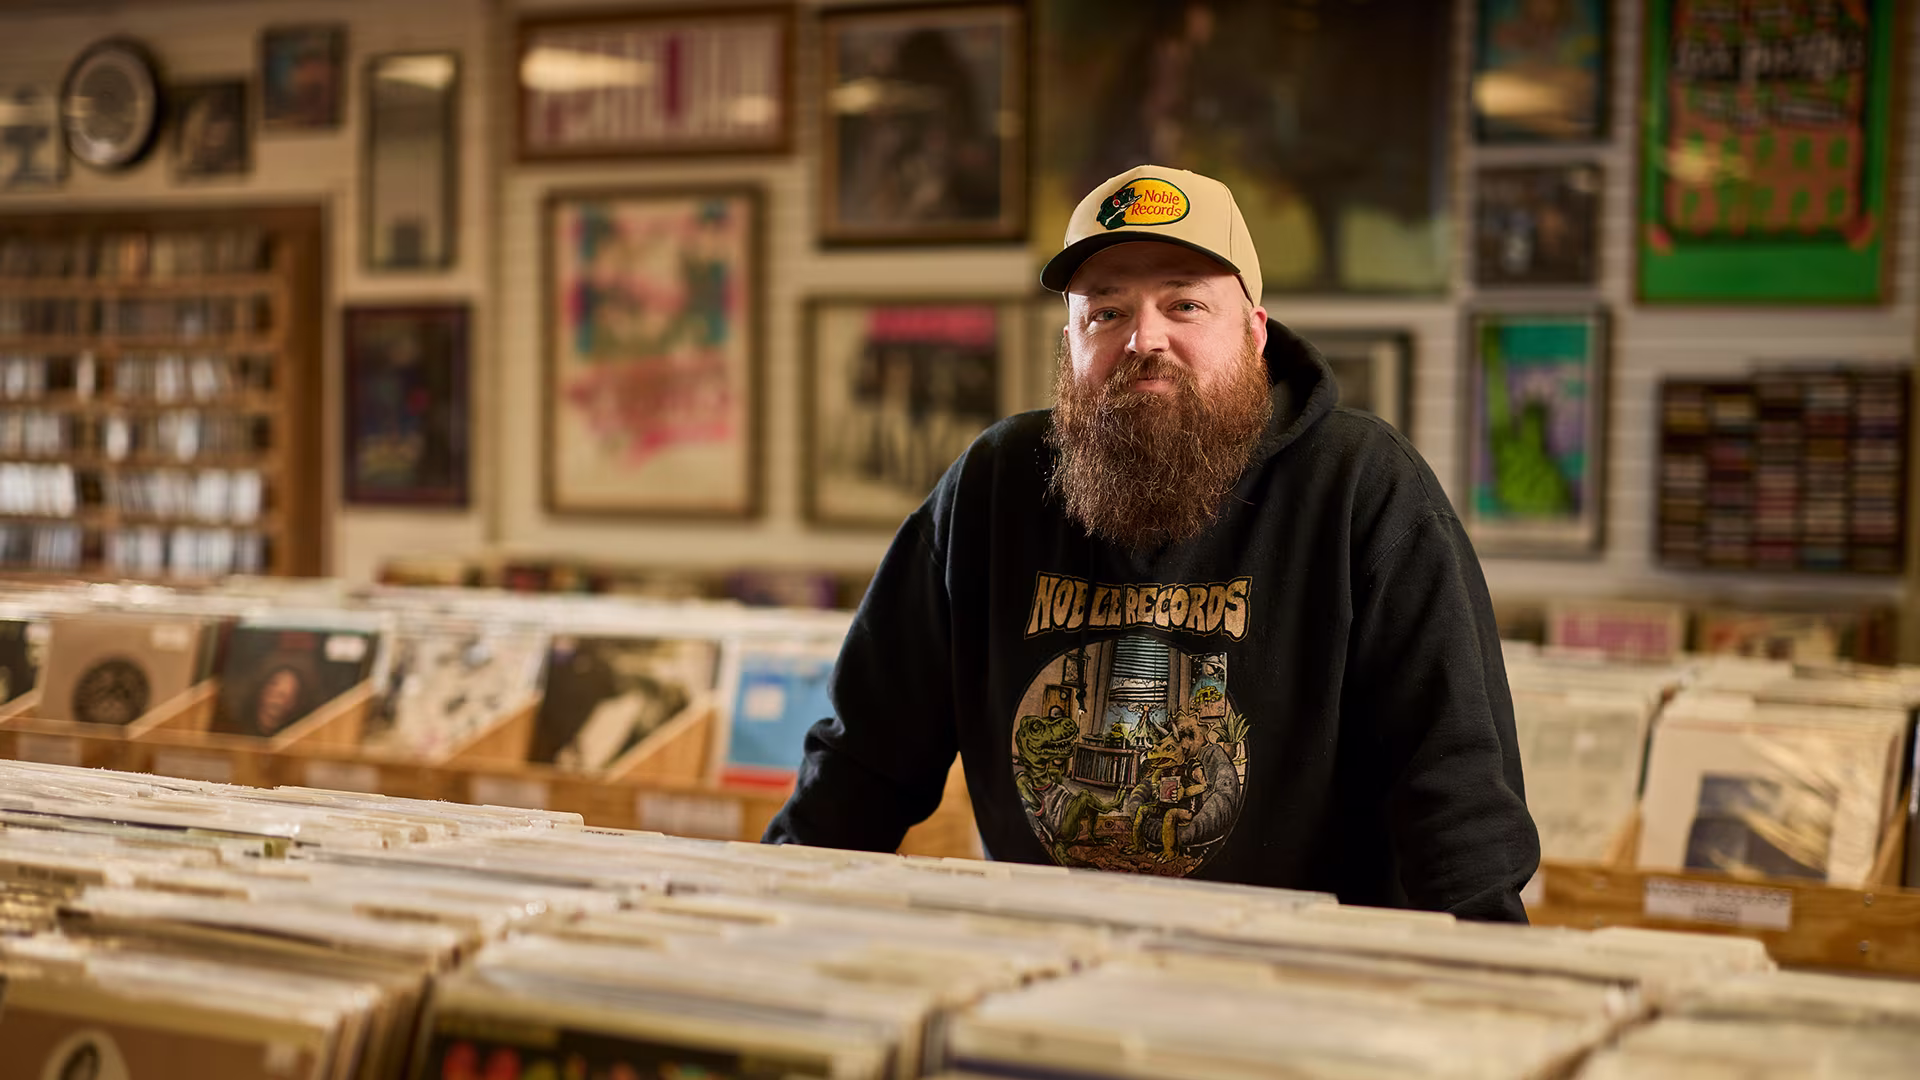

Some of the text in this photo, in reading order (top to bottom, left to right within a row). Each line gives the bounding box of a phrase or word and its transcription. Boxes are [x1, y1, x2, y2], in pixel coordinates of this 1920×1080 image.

[1143, 189, 1180, 205] Noble
[1131, 202, 1182, 217] Records
[1025, 572, 1251, 641] NOBLE RECORDS
